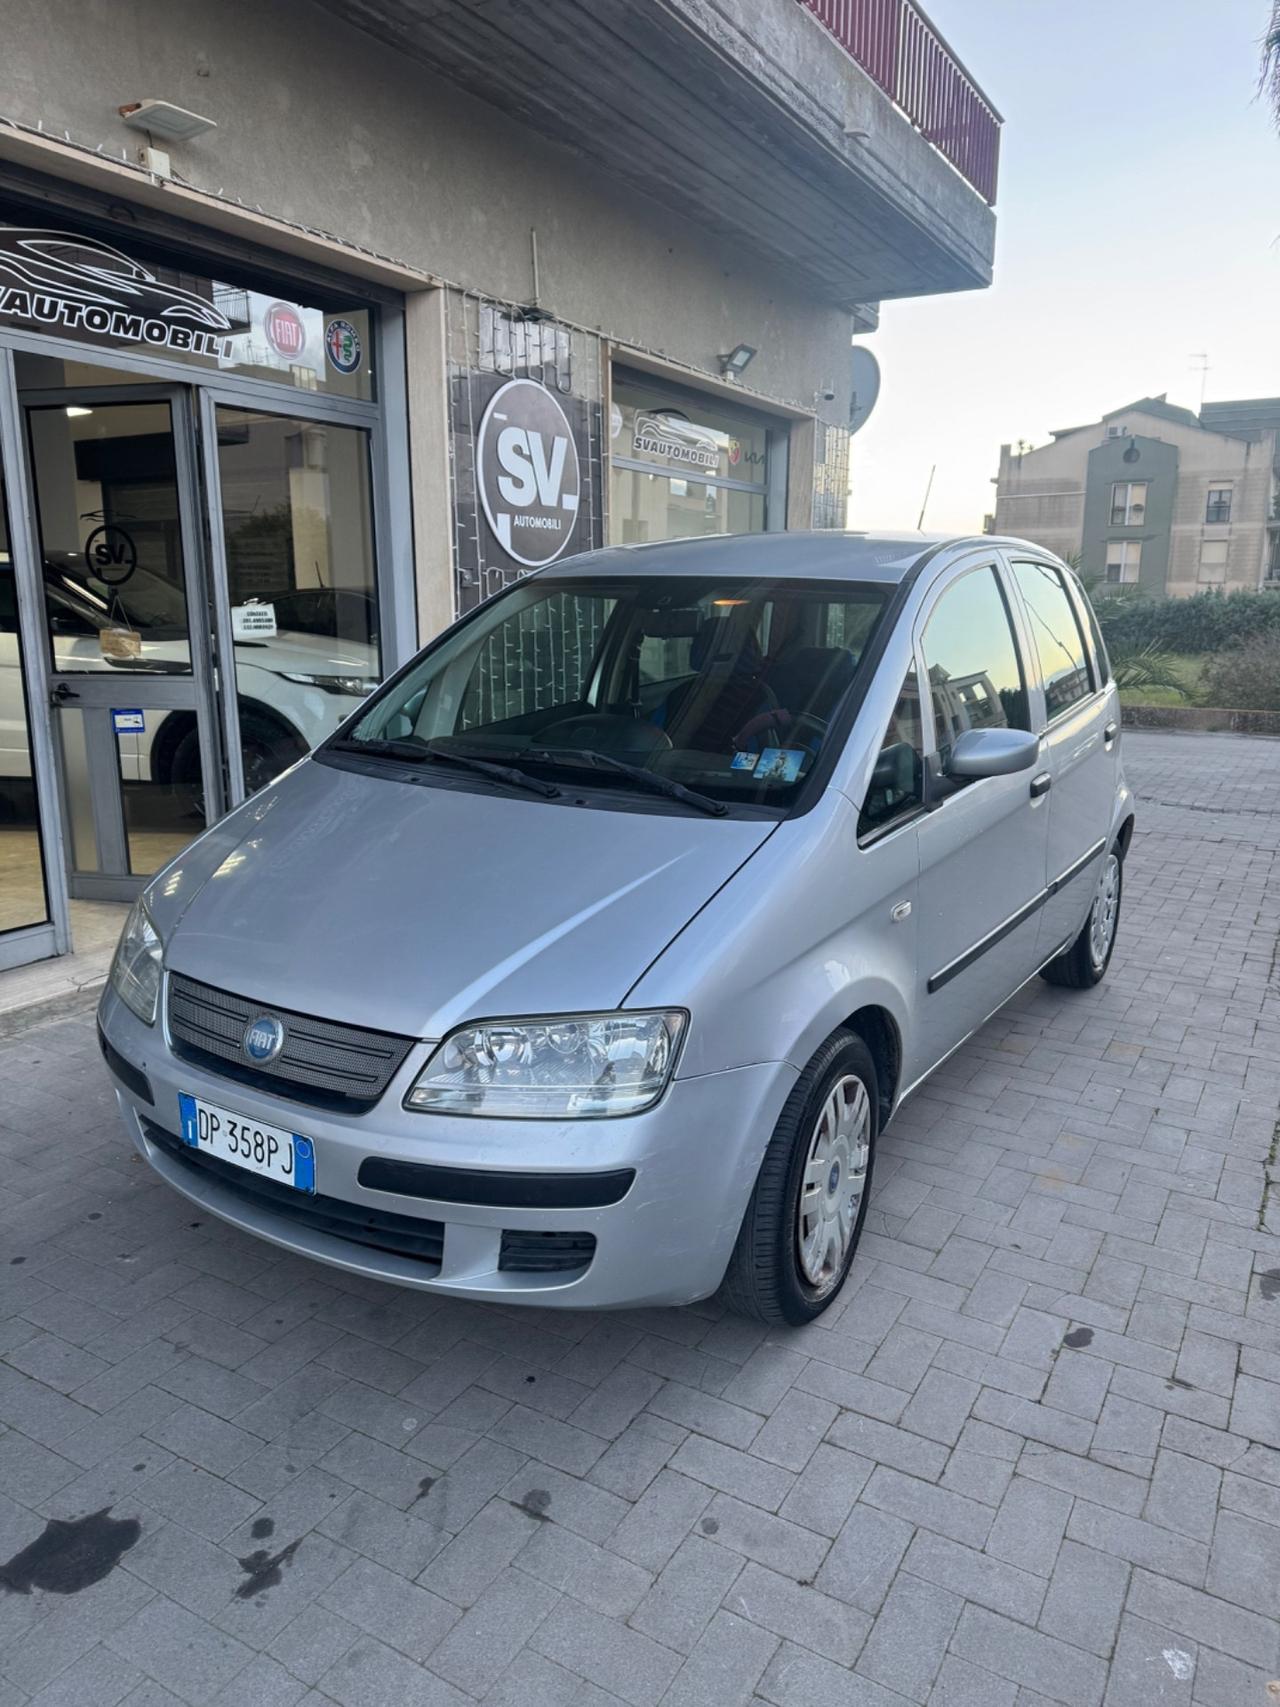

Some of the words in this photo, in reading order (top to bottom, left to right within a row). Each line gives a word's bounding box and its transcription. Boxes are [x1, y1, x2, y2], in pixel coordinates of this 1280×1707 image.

[275, 317, 299, 348] FIAT
[633, 436, 720, 469] SVAUTOMOBILI
[513, 514, 561, 531] AUTOMOBILI
[249, 1028, 276, 1050] FIAT
